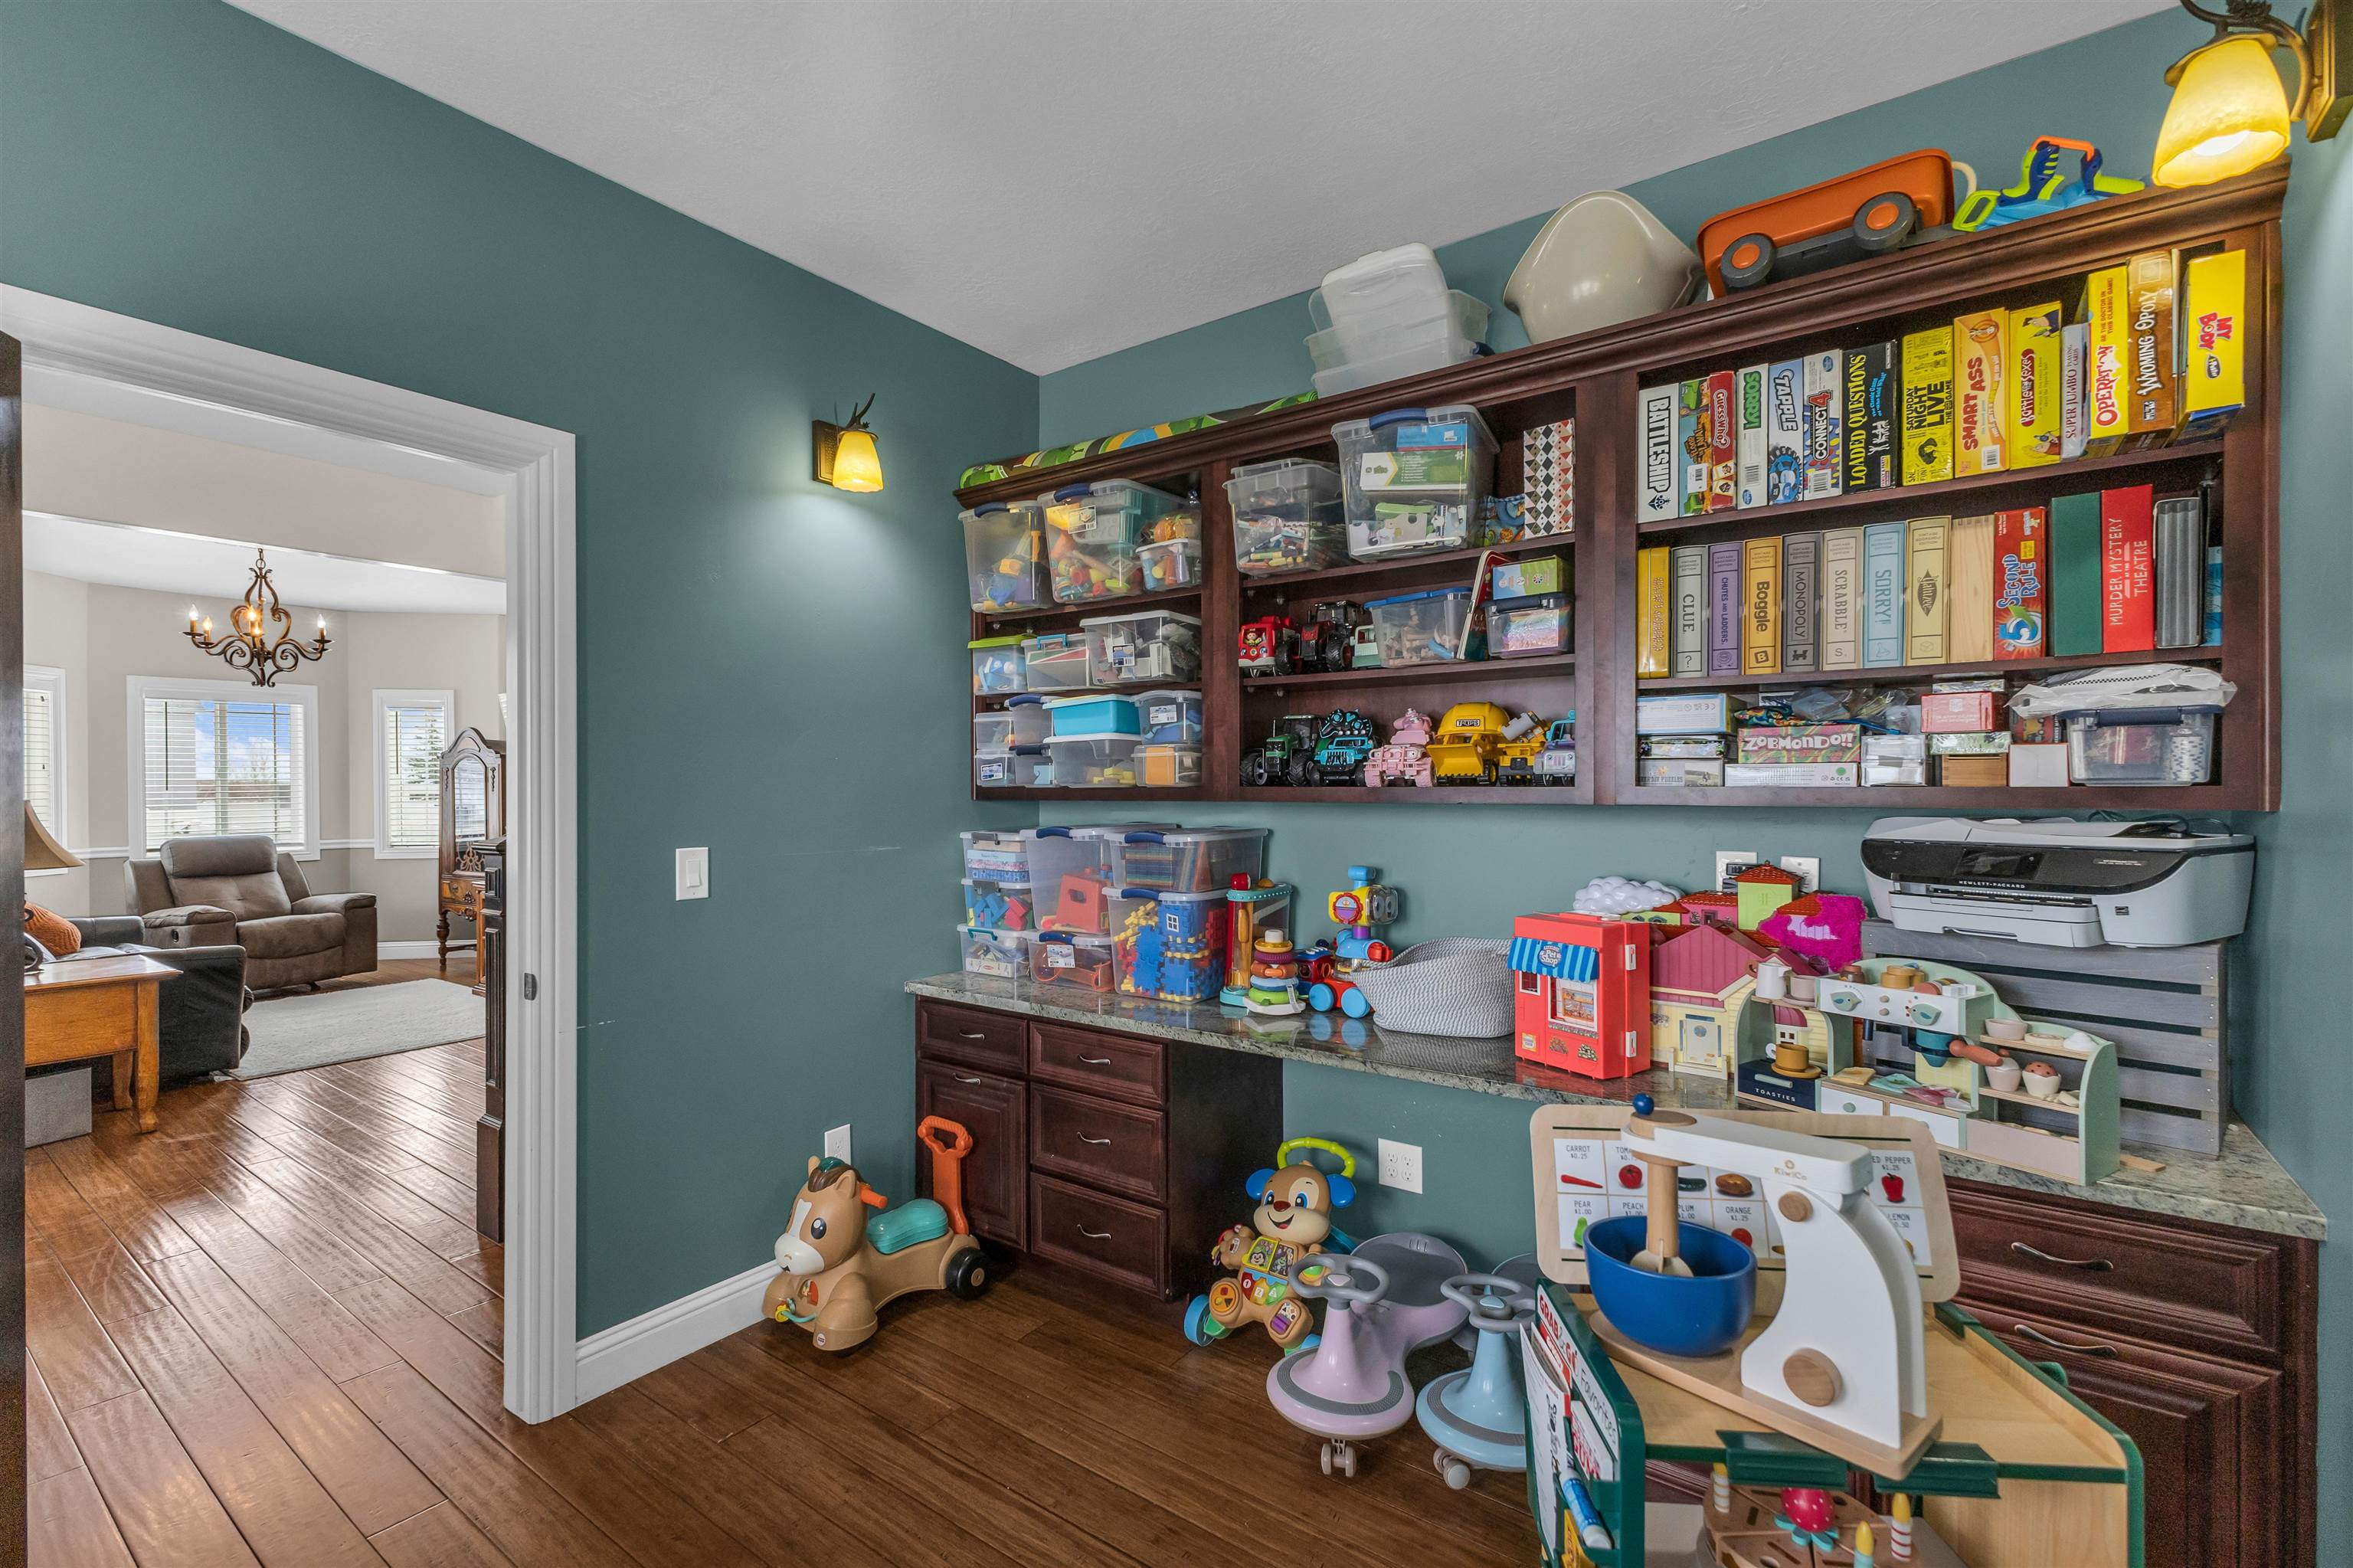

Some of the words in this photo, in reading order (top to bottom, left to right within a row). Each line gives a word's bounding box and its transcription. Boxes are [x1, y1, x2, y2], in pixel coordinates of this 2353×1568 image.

[2134, 290, 2158, 331] OPOLY
[2199, 312, 2218, 350] BODY
[2217, 316, 2232, 340] MY
[1967, 357, 1985, 392] ASS
[2066, 369, 2078, 404] JUMBO
[2136, 335, 2162, 396] WYOMING
[1774, 375, 1798, 431] TAPPLE
[1809, 391, 1831, 407] 4
[1848, 355, 1867, 427] QUESTIONS
[1914, 385, 1926, 430] NIGHT
[1927, 380, 1945, 427] LIVE
[1648, 396, 1671, 493] BATTLESHIP
[1815, 407, 1828, 460] CONNECT
[1962, 394, 1978, 450] SMART
[2065, 408, 2076, 438] SUPER
[1849, 430, 1867, 486] LOADED
[2109, 518, 2122, 573] MYSTERY
[2133, 540, 2148, 597] THEATRE
[1834, 570, 1847, 630] SCRABBLE
[1874, 570, 1892, 624] SORRY!
[1997, 554, 2021, 608] SECOND
[2020, 561, 2041, 598] RULE
[2109, 576, 2123, 625] MURDER
[1683, 594, 1695, 632] CLUE
[1754, 581, 1770, 632] Boggle
[1795, 571, 1806, 637] MONOPOLY
[1998, 617, 2038, 641] 5
[1959, 880, 2026, 889] HEWLETT-PACKARD
[1541, 955, 1558, 965] Shop
[1546, 950, 1556, 958] Pet
[1756, 1088, 1796, 1102] TOASTIES
[1885, 1156, 1912, 1164] PEPPER
[1726, 1206, 1752, 1215] ORANGE
[1539, 1294, 1559, 1340] GRAB
[1581, 1368, 1616, 1444] Favorites
